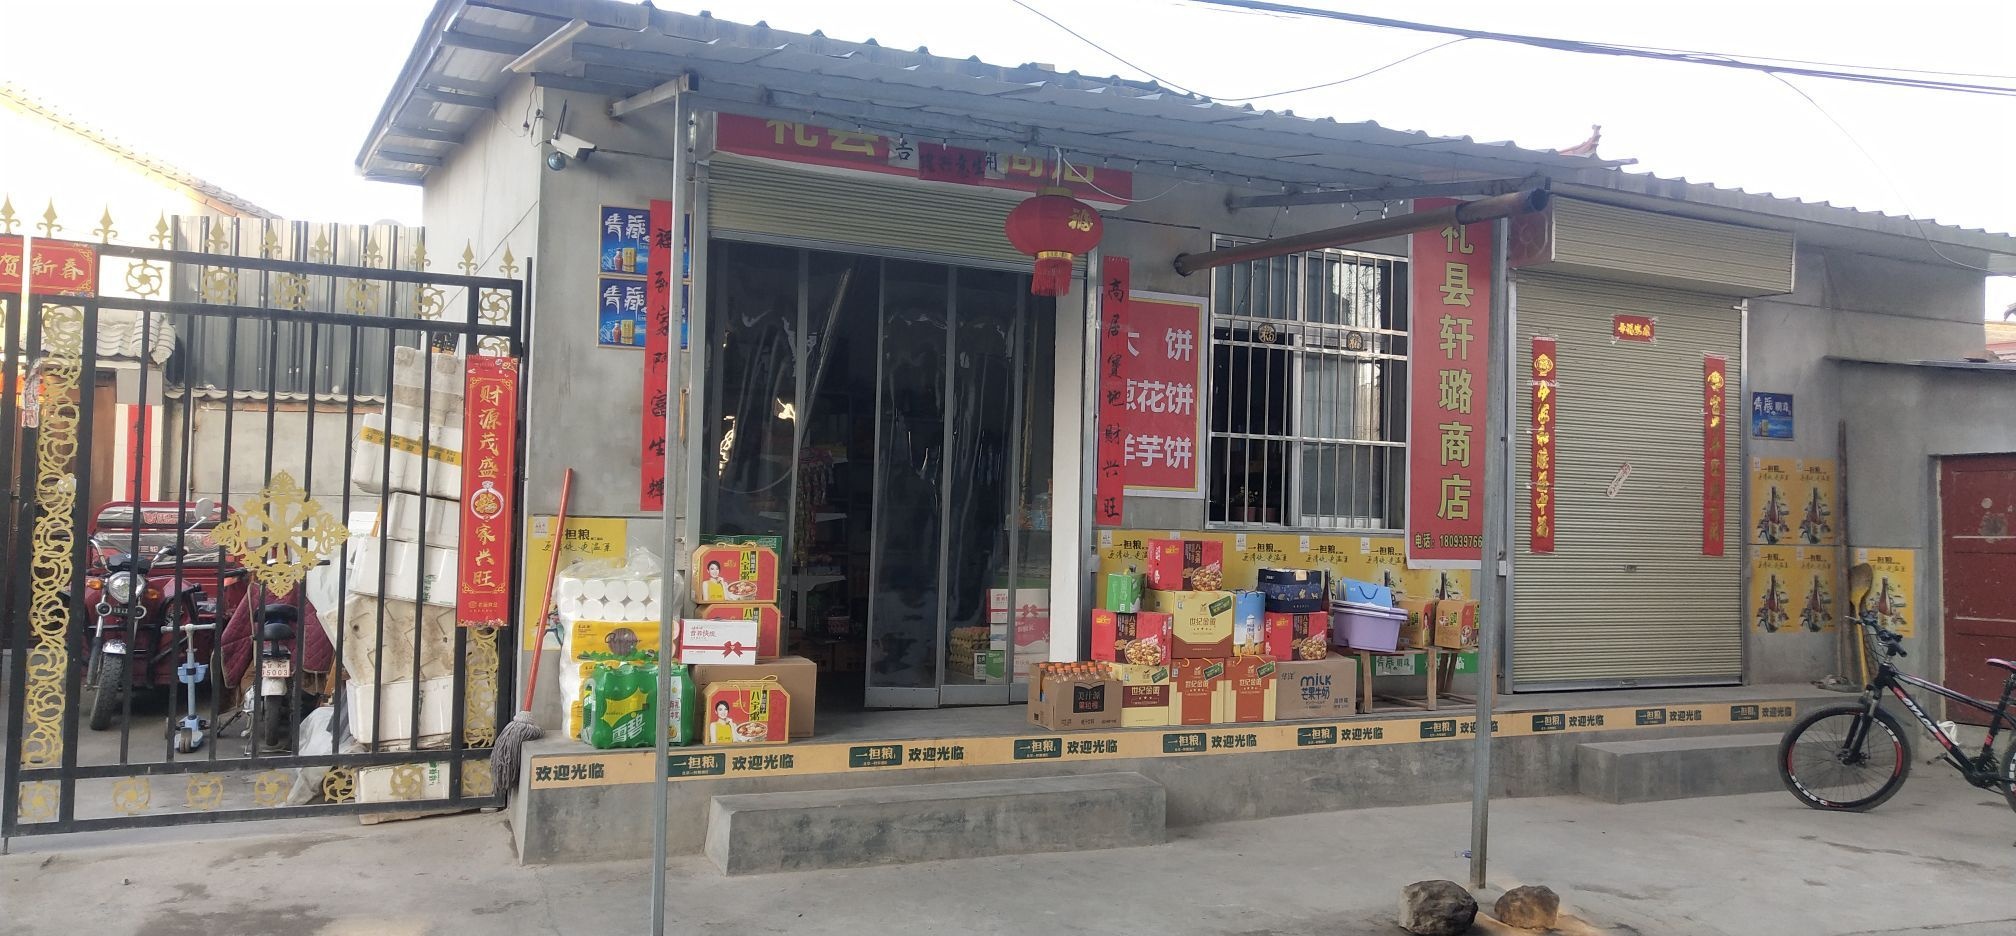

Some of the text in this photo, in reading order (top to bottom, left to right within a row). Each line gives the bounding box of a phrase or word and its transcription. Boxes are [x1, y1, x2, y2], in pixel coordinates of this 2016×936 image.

[612, 714, 645, 741] 雪碧
[1341, 727, 1384, 742] 欢迎光临
[1019, 741, 1054, 753] 一担粮
[1066, 739, 1118, 755] 欢迎光临
[1211, 733, 1257, 749] 欢迎光临
[855, 747, 894, 760] 一担粮
[908, 746, 964, 762] 欢迎光临
[673, 755, 715, 769] 一担粮
[731, 754, 794, 771] 欢迎光临
[535, 762, 605, 782] 欢迎光临
